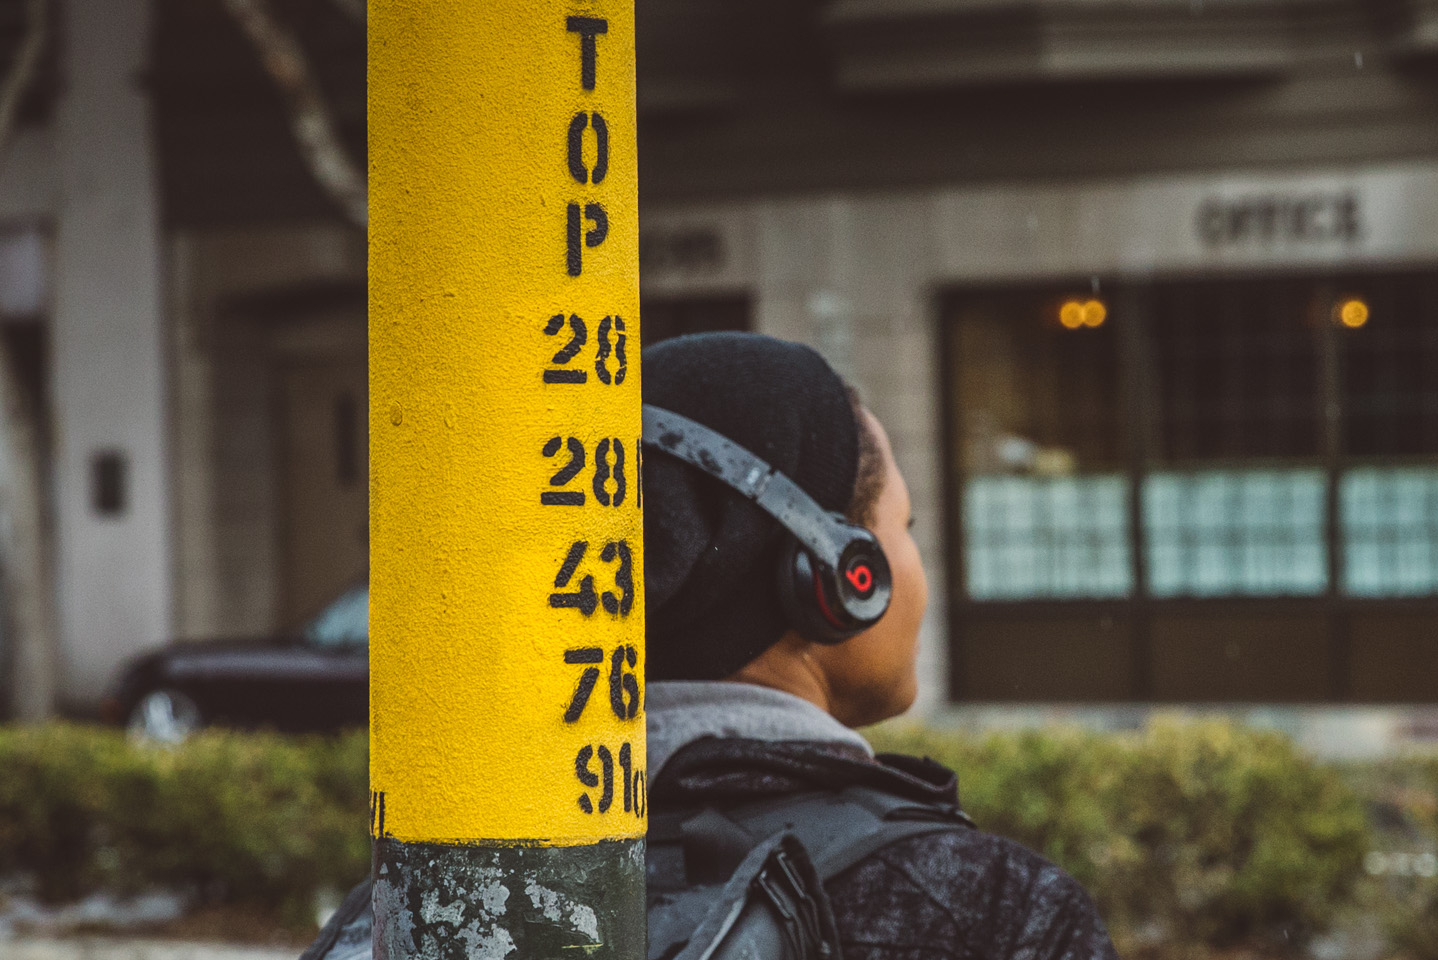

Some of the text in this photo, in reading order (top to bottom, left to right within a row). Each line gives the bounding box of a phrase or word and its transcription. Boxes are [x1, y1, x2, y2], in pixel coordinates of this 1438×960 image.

[1197, 194, 1358, 248] OFFICE
[543, 313, 628, 385] 28
[548, 540, 634, 617] 43
[563, 645, 640, 723] 76
